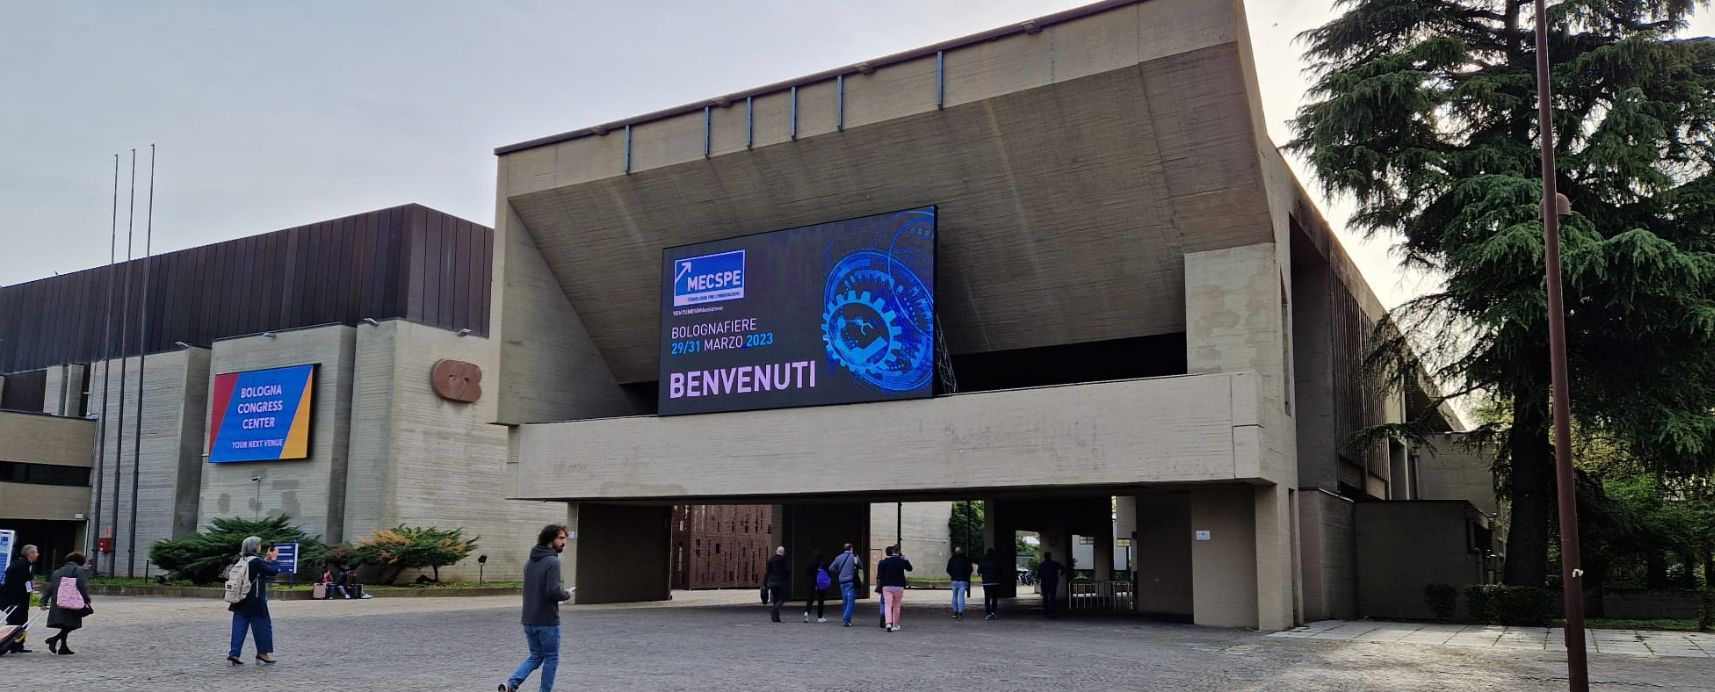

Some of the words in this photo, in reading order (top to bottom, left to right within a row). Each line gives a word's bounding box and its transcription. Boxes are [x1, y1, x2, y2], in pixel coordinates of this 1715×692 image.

[687, 270, 741, 292] MECSPE
[671, 318, 757, 339] BOLOGNAFIERE
[671, 340, 700, 355] 29/31
[704, 335, 743, 351] MARZO
[746, 332, 774, 347] 2023
[669, 360, 816, 399] BENVENUTI
[241, 384, 282, 399] BOLOGNA
[237, 400, 283, 414] CONGRESS
[242, 417, 275, 430] CENTER
[232, 441, 248, 449] YOUR
[249, 440, 263, 448] NEXT
[264, 438, 284, 447] VENUE
